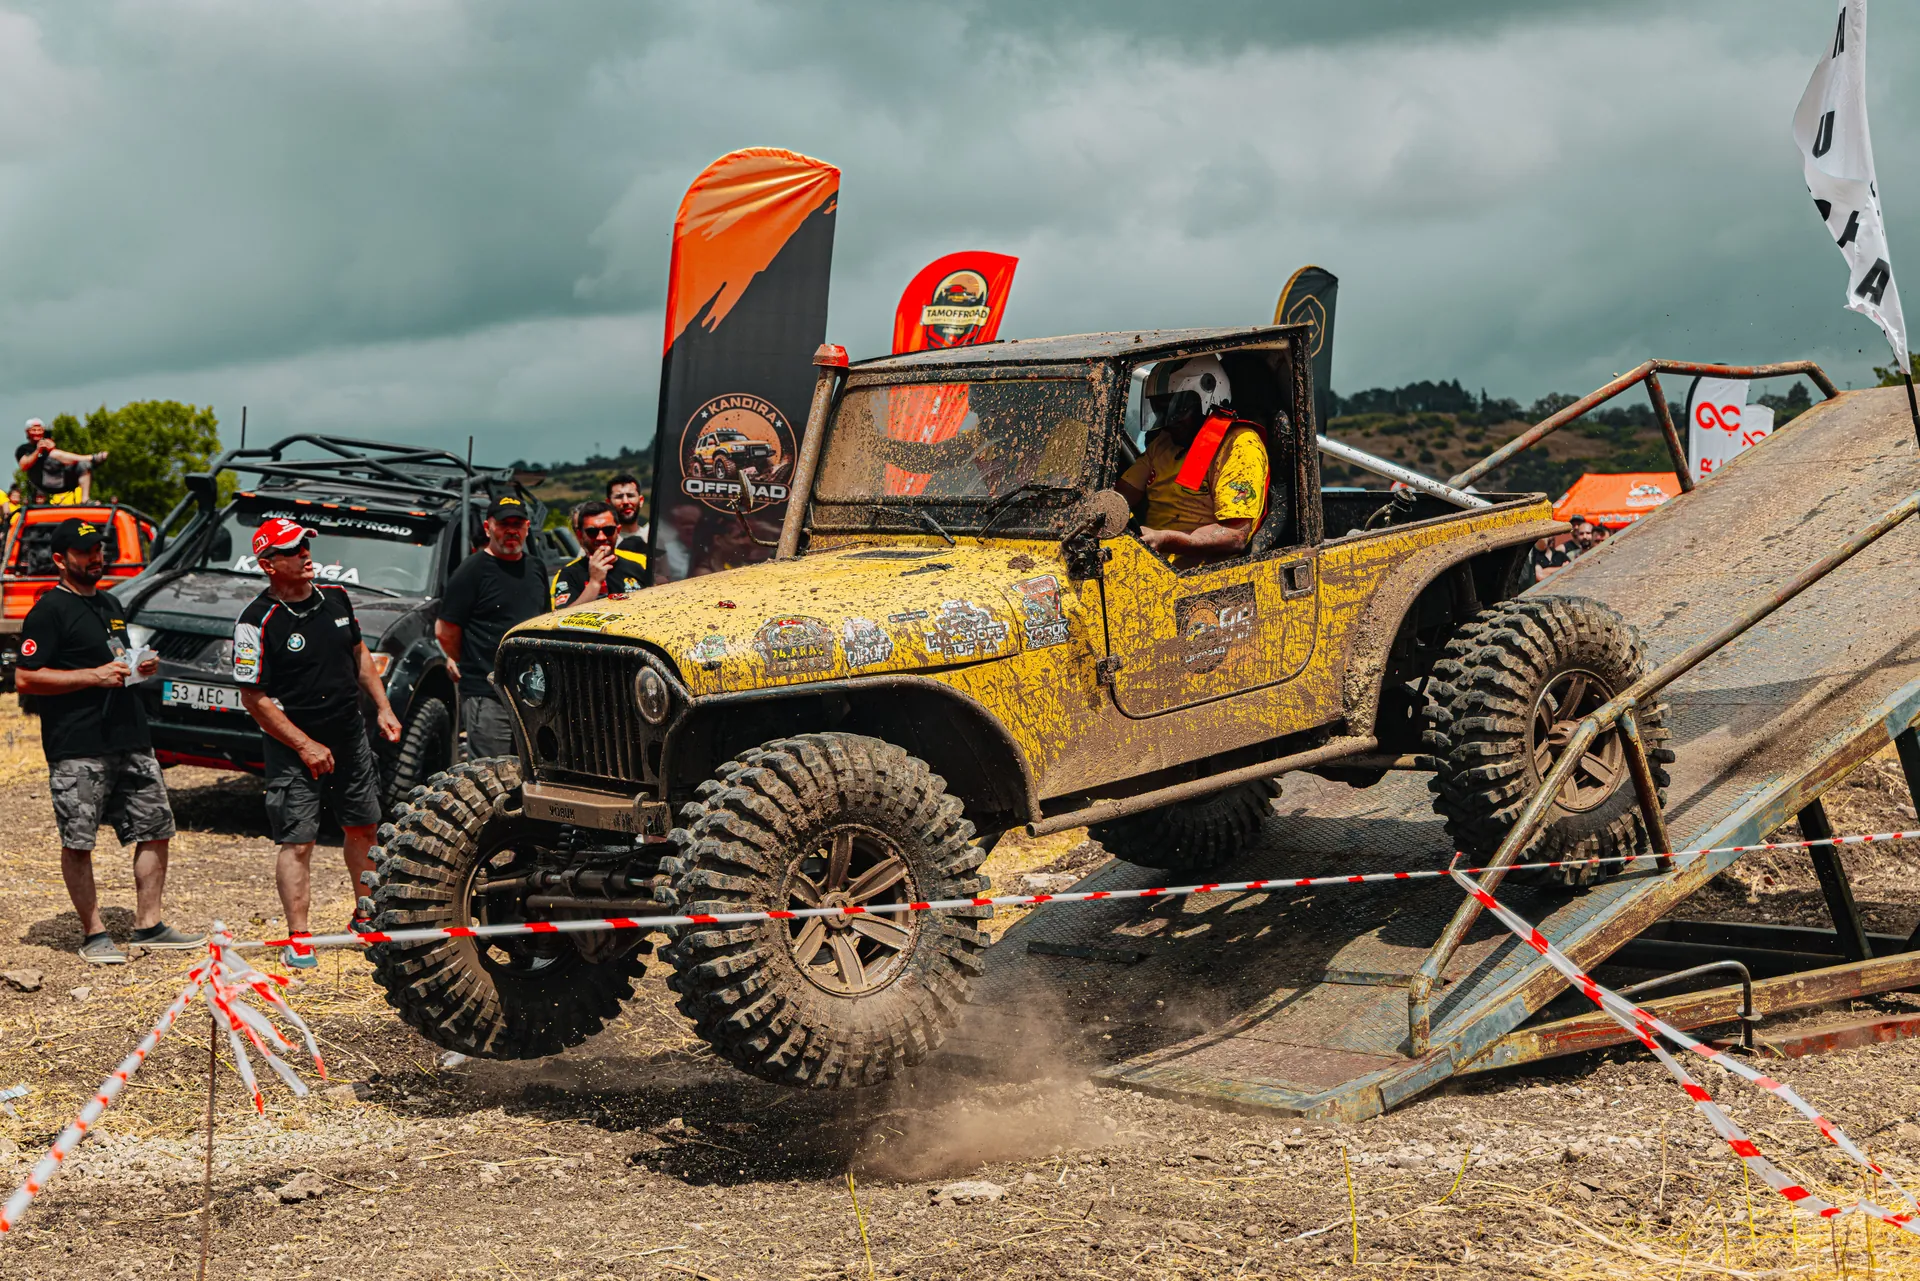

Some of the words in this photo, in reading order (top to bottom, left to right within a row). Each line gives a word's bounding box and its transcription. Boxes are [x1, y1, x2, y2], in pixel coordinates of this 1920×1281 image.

[926, 309, 988, 319] TAMOFFROAD
[708, 396, 777, 424] KANDIRA
[336, 516, 413, 537] OFFROAD
[171, 683, 189, 700] 53
[199, 687, 225, 704] AEC
